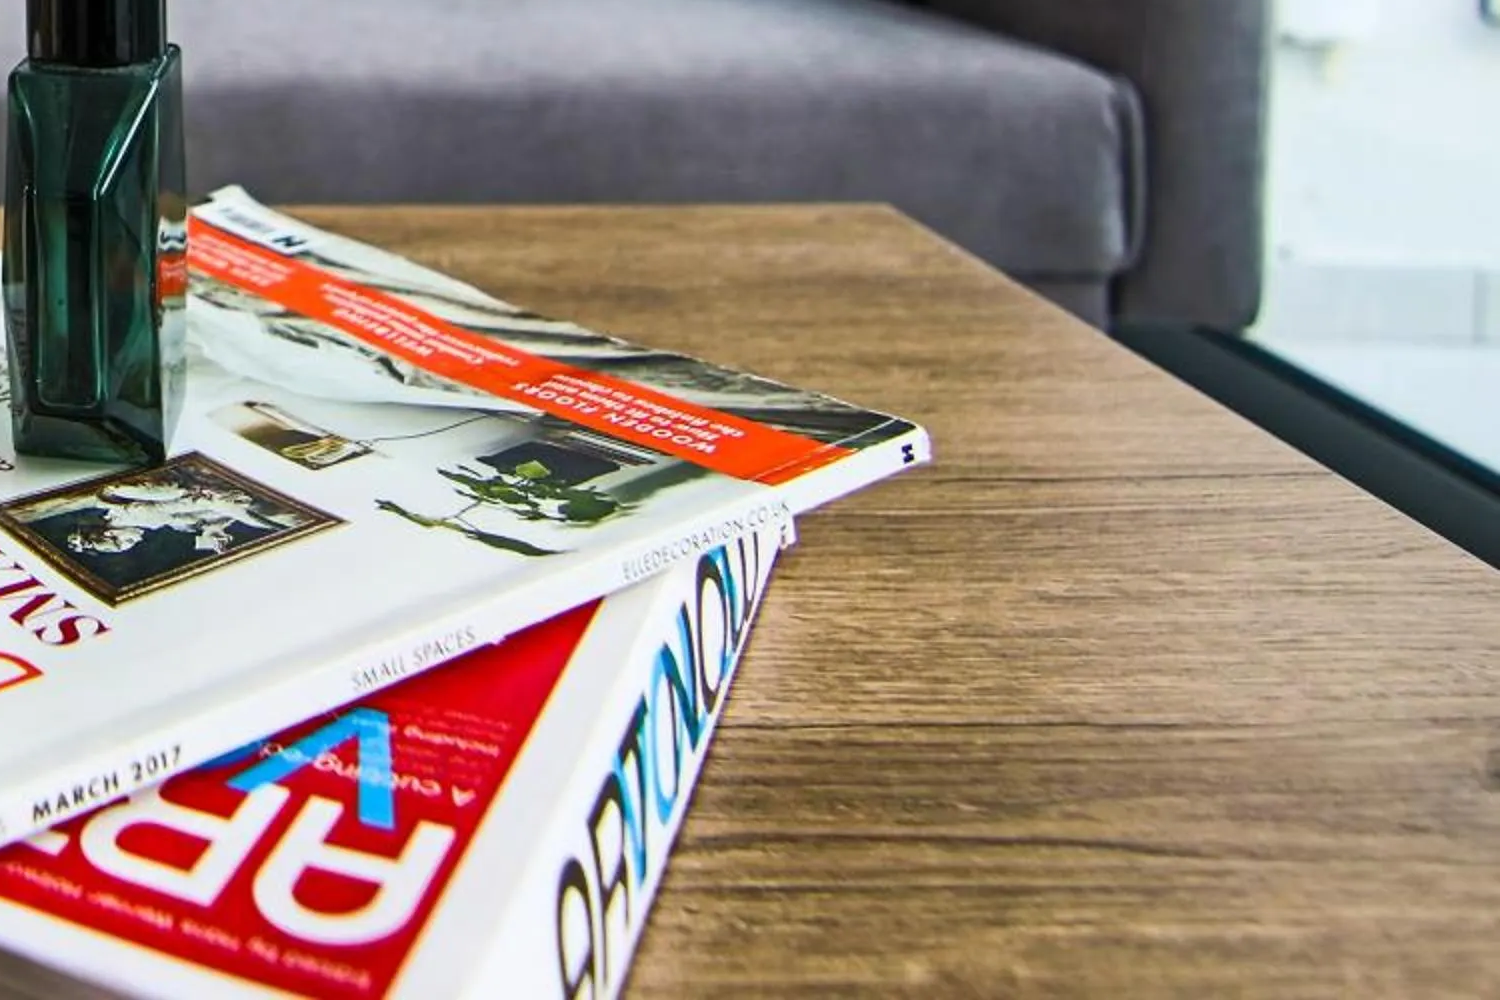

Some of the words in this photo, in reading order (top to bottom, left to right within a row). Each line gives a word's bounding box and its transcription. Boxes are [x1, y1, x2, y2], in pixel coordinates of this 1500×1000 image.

[512, 382, 600, 414] FLOORS
[604, 413, 717, 454] WOODEN
[33, 772, 120, 822] MARCH
[131, 745, 182, 783] 2017
[351, 653, 406, 692] SMALL
[412, 624, 476, 667] SPACES
[451, 784, 477, 807] A
[22, 782, 457, 946] AR
